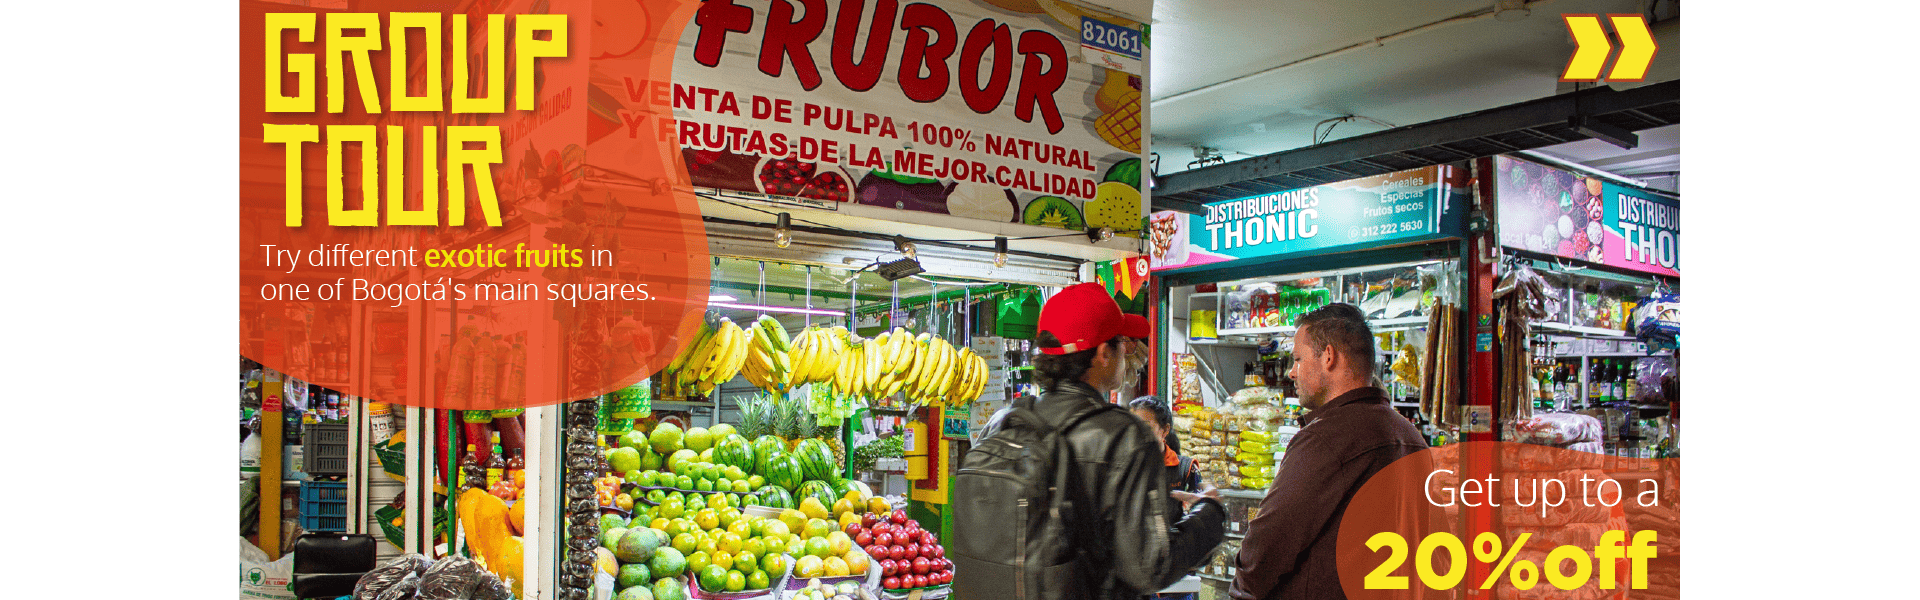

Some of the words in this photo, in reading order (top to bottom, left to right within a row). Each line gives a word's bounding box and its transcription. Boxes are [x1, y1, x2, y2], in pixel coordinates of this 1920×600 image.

[1083, 21, 1140, 53] 82061
[694, 0, 1068, 135] FRUBOR
[624, 77, 740, 117] VENTA
[752, 95, 792, 124] DE
[803, 103, 898, 139] PULPA
[907, 121, 976, 152] 100%
[985, 133, 1096, 171] NATURAL
[624, 113, 646, 139] Y
[658, 119, 788, 157] FRUTAS
[800, 136, 838, 163] DE
[849, 144, 884, 170] LA
[894, 150, 988, 184] MEJOR
[995, 165, 1096, 200] CALIDAD
[1381, 189, 1423, 203] Especias
[1382, 176, 1423, 190] Cereales
[1206, 187, 1319, 223] DISTRIBUICIONES
[1364, 206, 1393, 218] Frutos
[1395, 202, 1423, 213] secos
[1618, 193, 1680, 230] DISTRIBUI
[1206, 209, 1318, 250] THONIC
[1362, 225, 1379, 237] 312
[1381, 223, 1397, 235] 222
[1400, 220, 1423, 231] 5630
